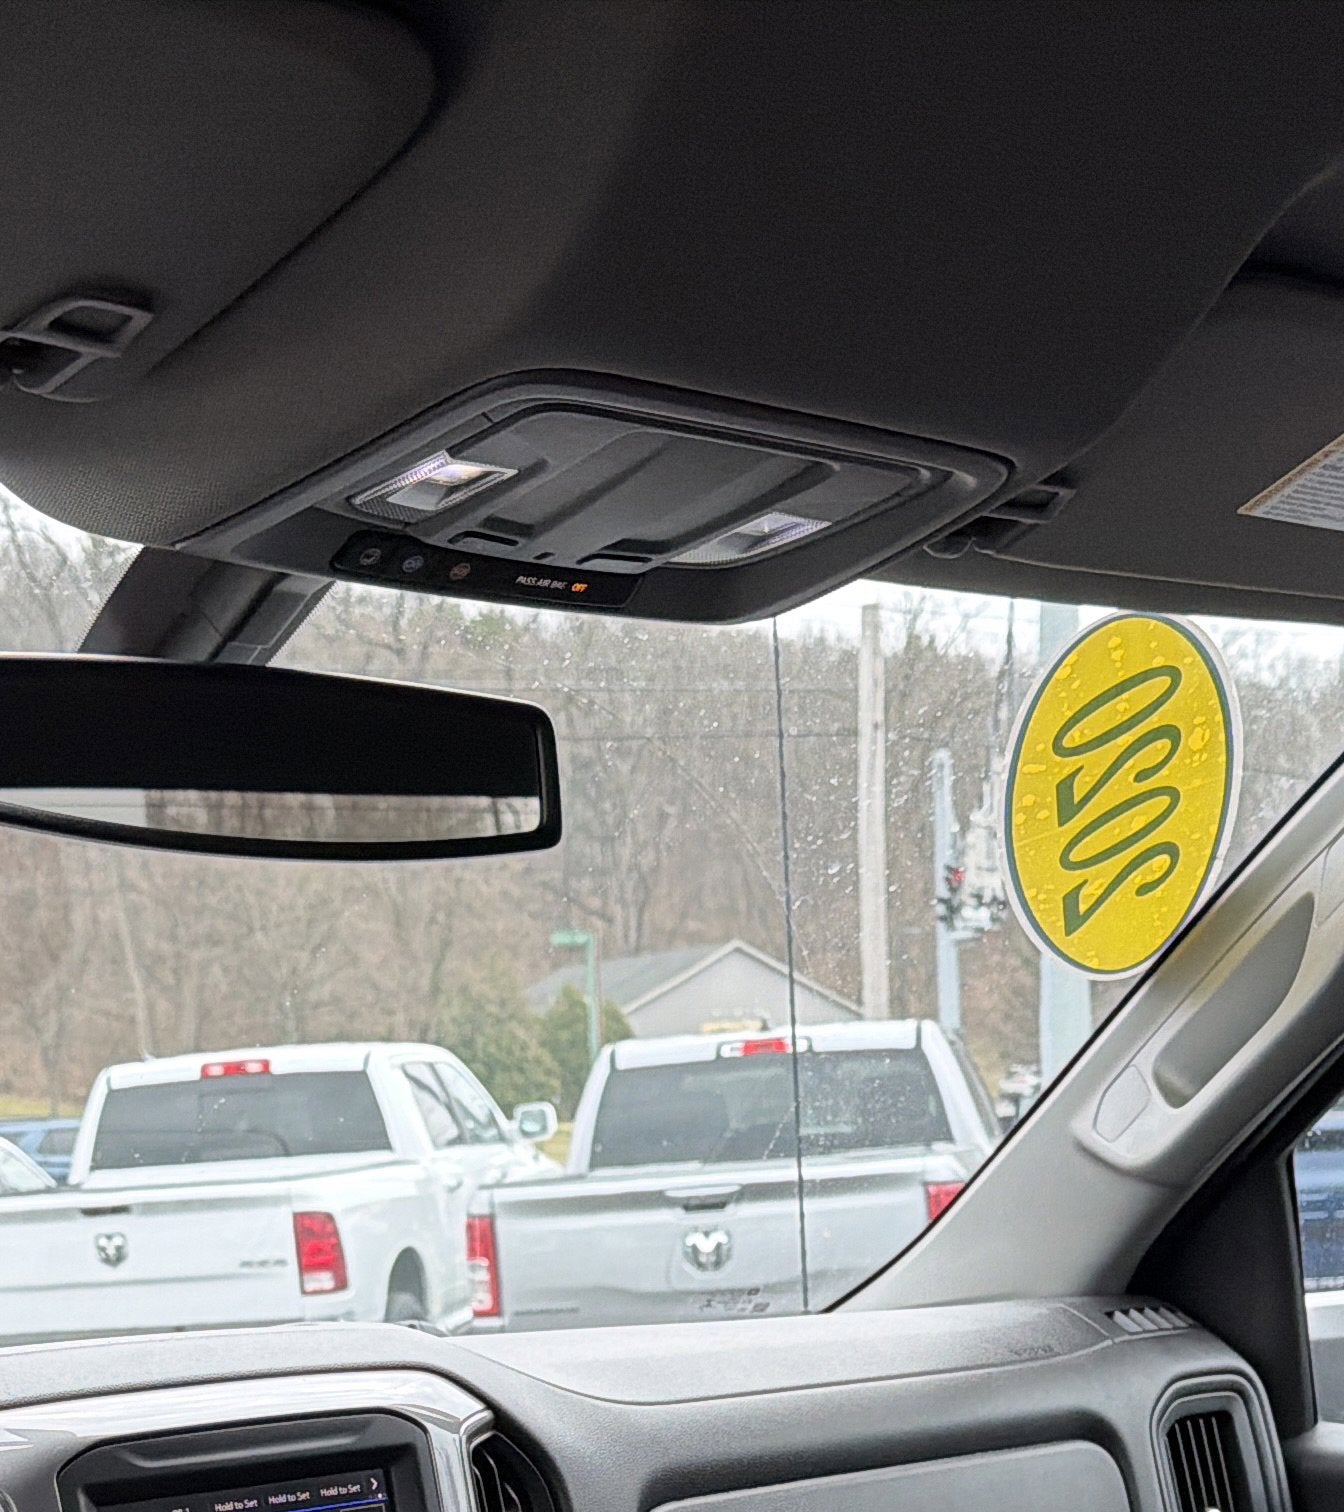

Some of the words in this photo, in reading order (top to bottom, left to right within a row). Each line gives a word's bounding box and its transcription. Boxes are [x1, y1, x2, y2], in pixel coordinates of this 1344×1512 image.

[319, 1486, 338, 1497] Hold
[338, 1485, 348, 1494] to
[347, 1483, 361, 1493] Set
[214, 1501, 234, 1512] Hold
[234, 1500, 243, 1510] to
[244, 1498, 259, 1509] Set
[268, 1493, 287, 1505] Hold
[287, 1493, 296, 1502] to
[296, 1491, 311, 1501] Set
